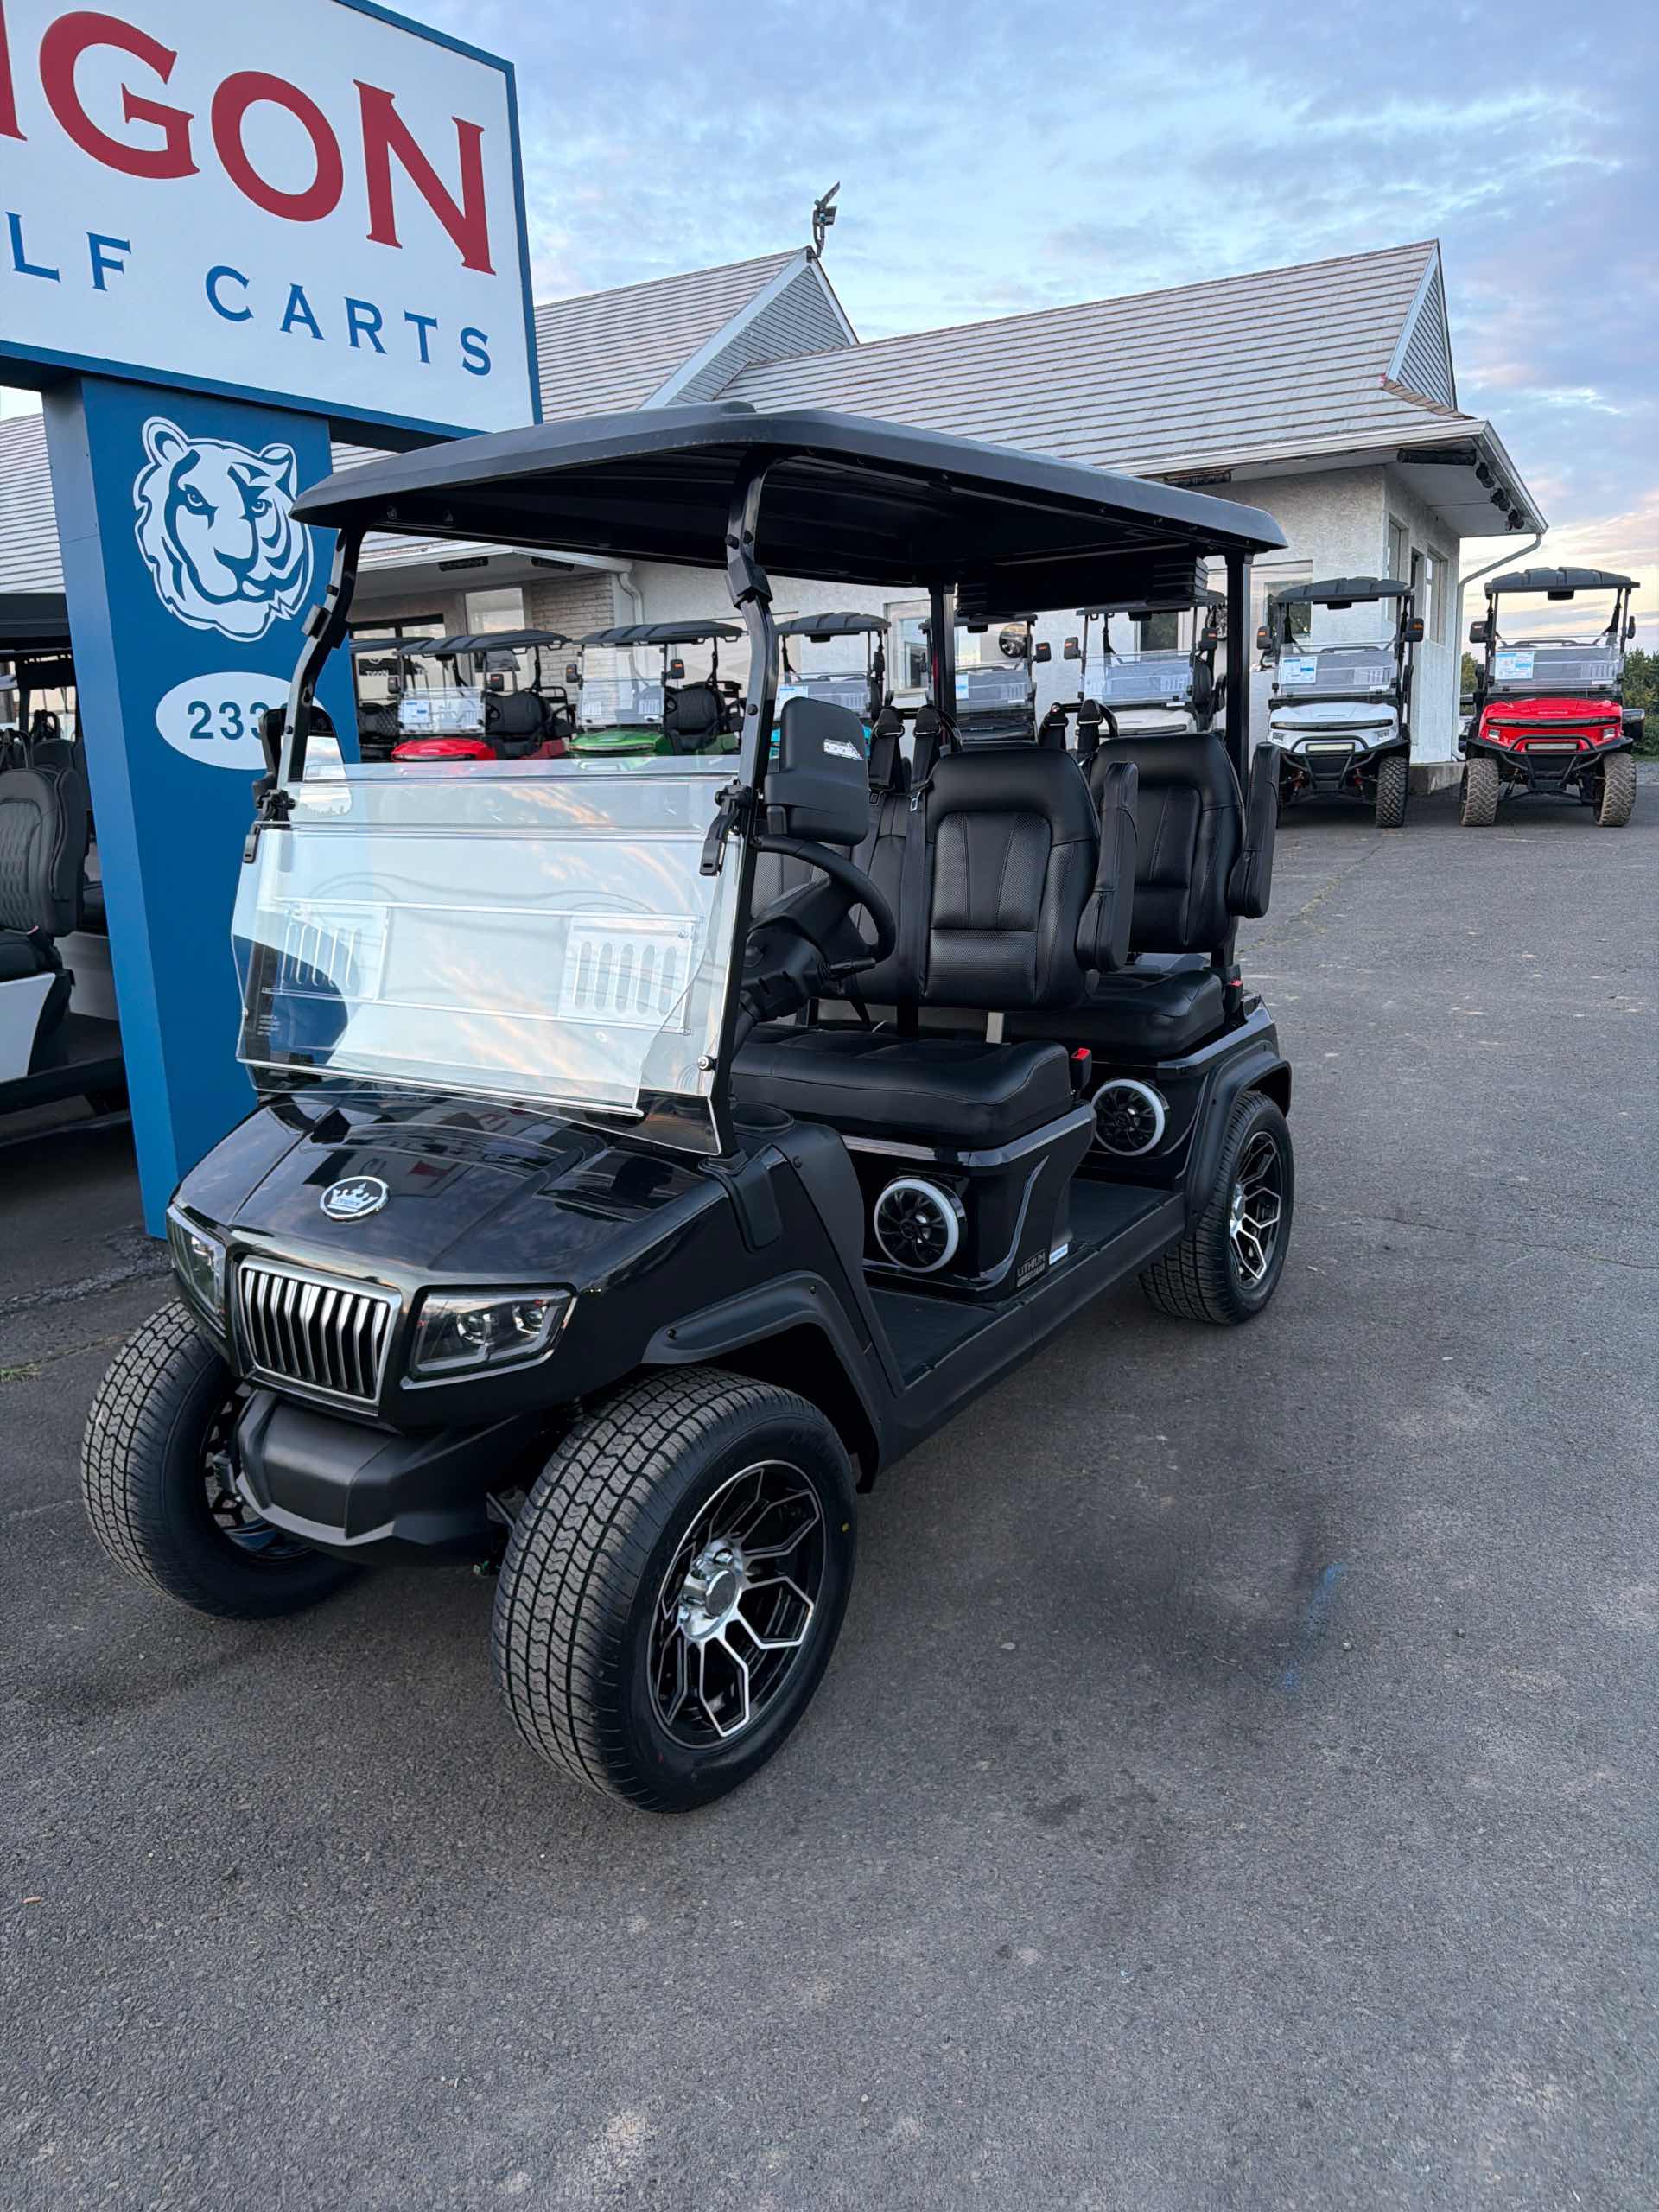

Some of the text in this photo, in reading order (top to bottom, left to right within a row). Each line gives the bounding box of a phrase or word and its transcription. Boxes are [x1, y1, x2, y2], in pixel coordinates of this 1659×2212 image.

[5, 211, 492, 376] LF CARTS
[187, 700, 288, 741] 233
